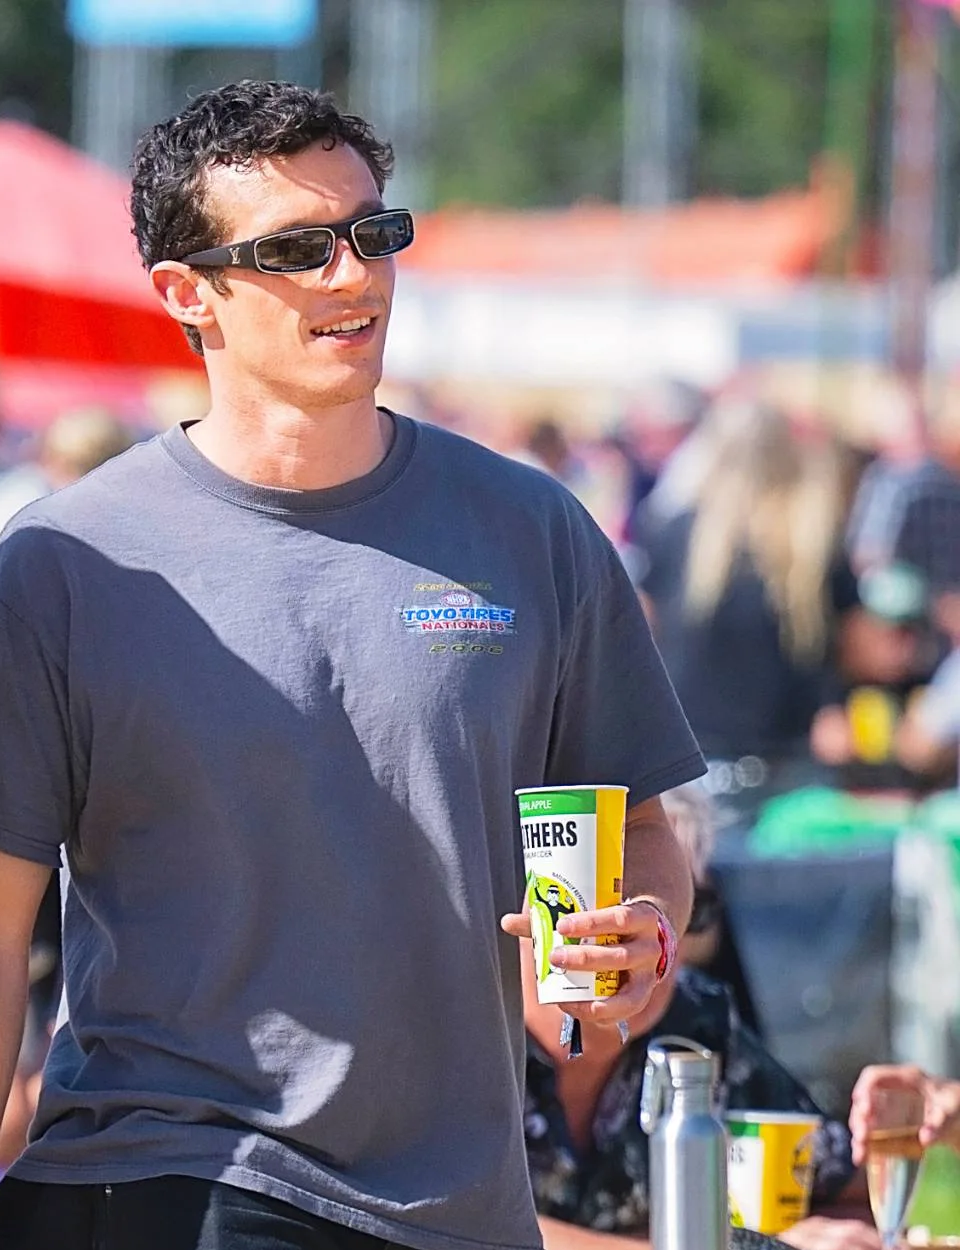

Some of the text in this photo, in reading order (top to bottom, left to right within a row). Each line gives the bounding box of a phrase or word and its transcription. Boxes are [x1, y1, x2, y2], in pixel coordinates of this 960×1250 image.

[404, 607, 512, 622] TOYO TIRES
[421, 621, 505, 631] NATIONALS
[521, 820, 578, 849] THERS
